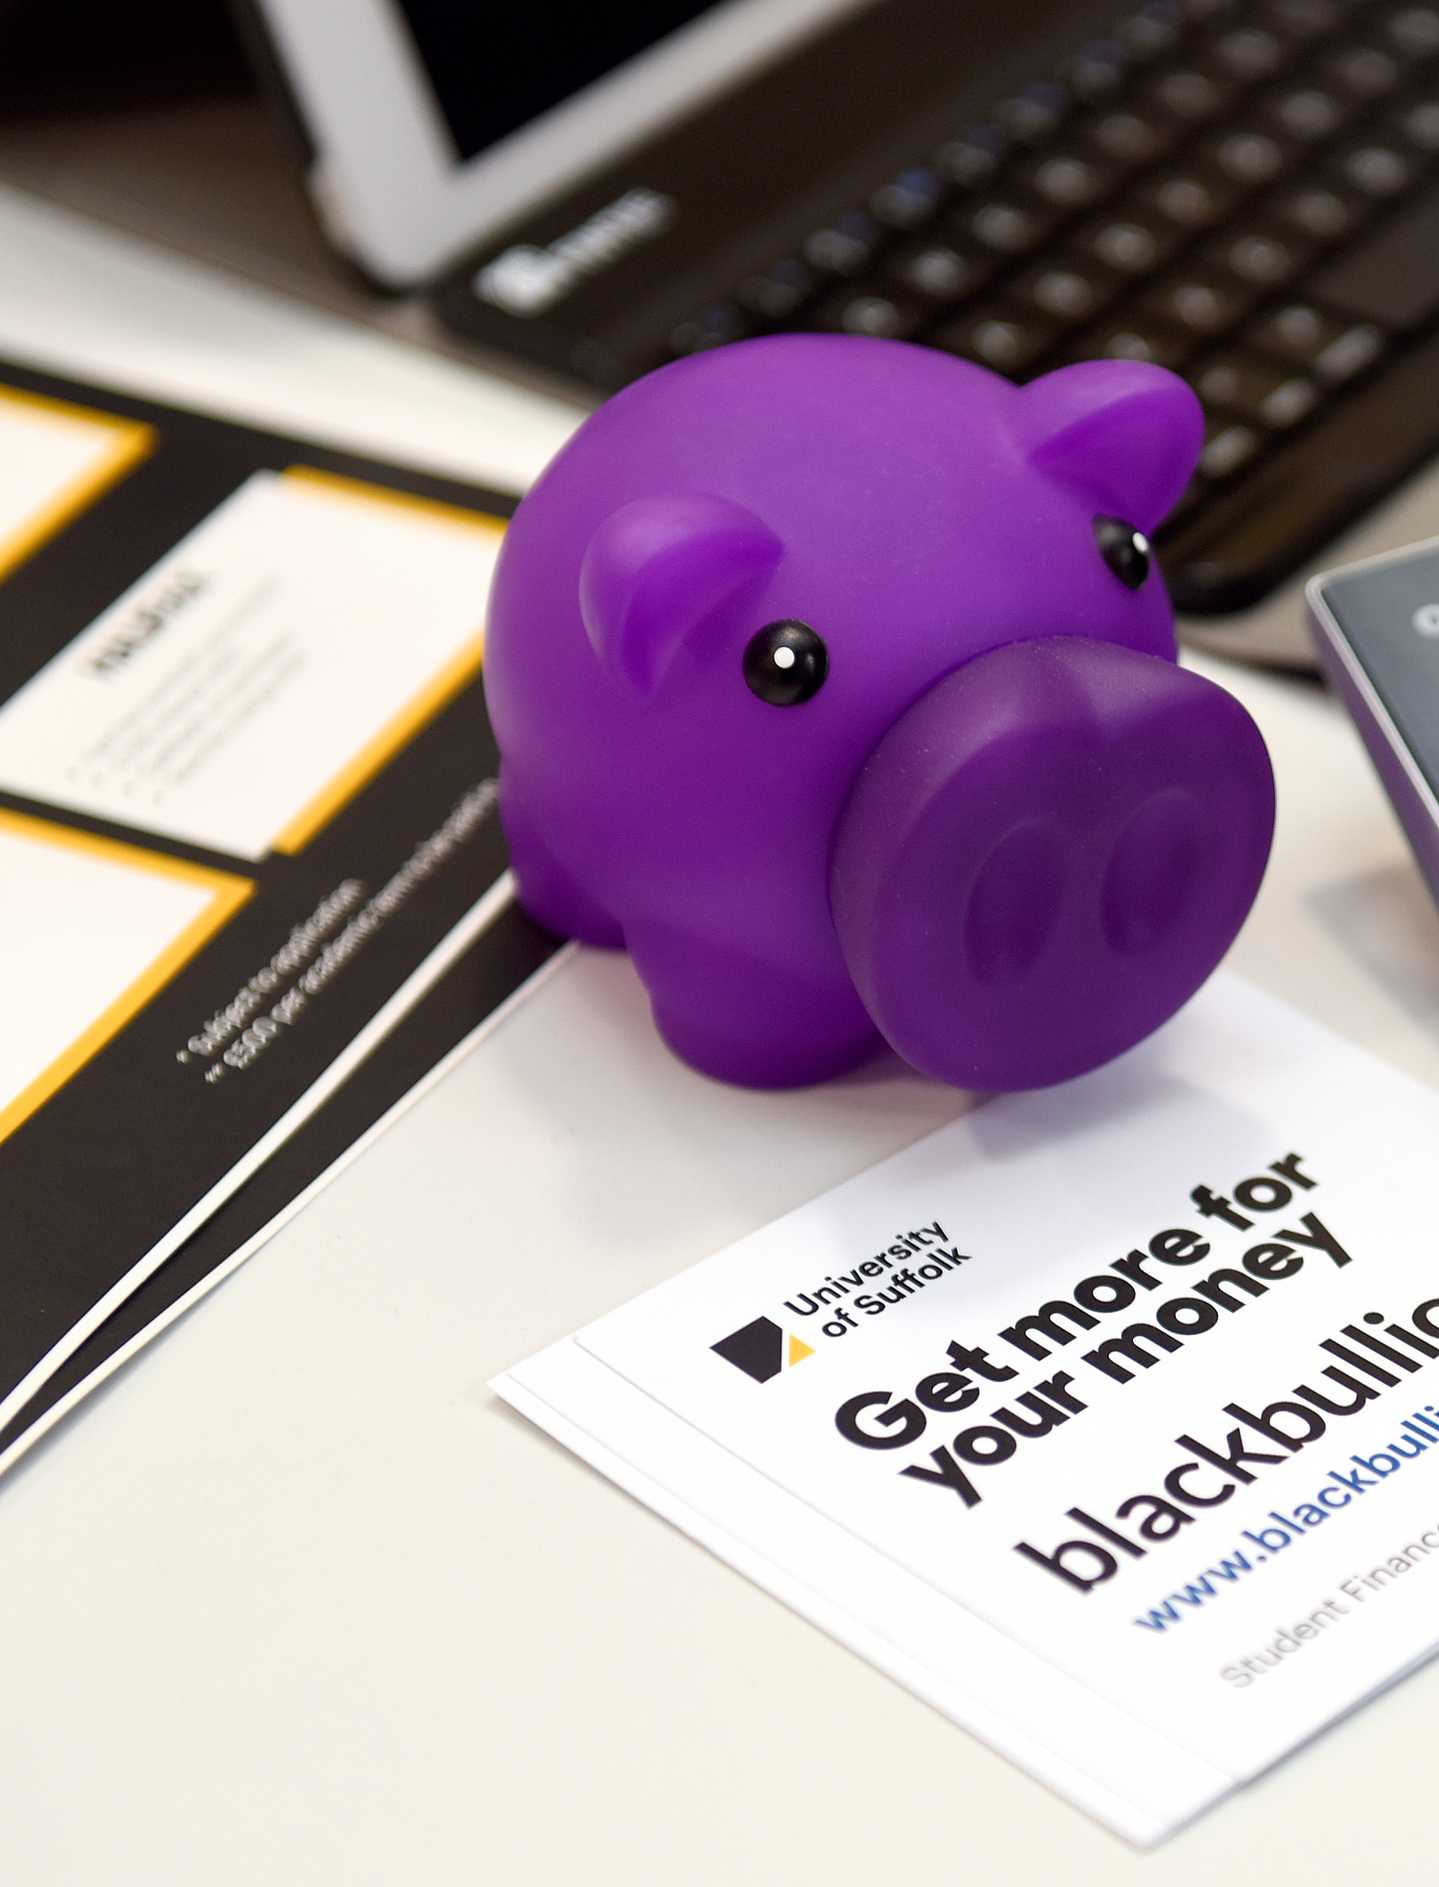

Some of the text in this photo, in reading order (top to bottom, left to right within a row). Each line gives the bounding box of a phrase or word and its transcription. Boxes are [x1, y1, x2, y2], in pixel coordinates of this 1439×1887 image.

[783, 1220, 950, 1317] University
[821, 1246, 974, 1338] of Suffolk
[834, 1151, 1319, 1451] Get more for
[898, 1211, 1353, 1510] your money
[1218, 1597, 1349, 1689] Student
